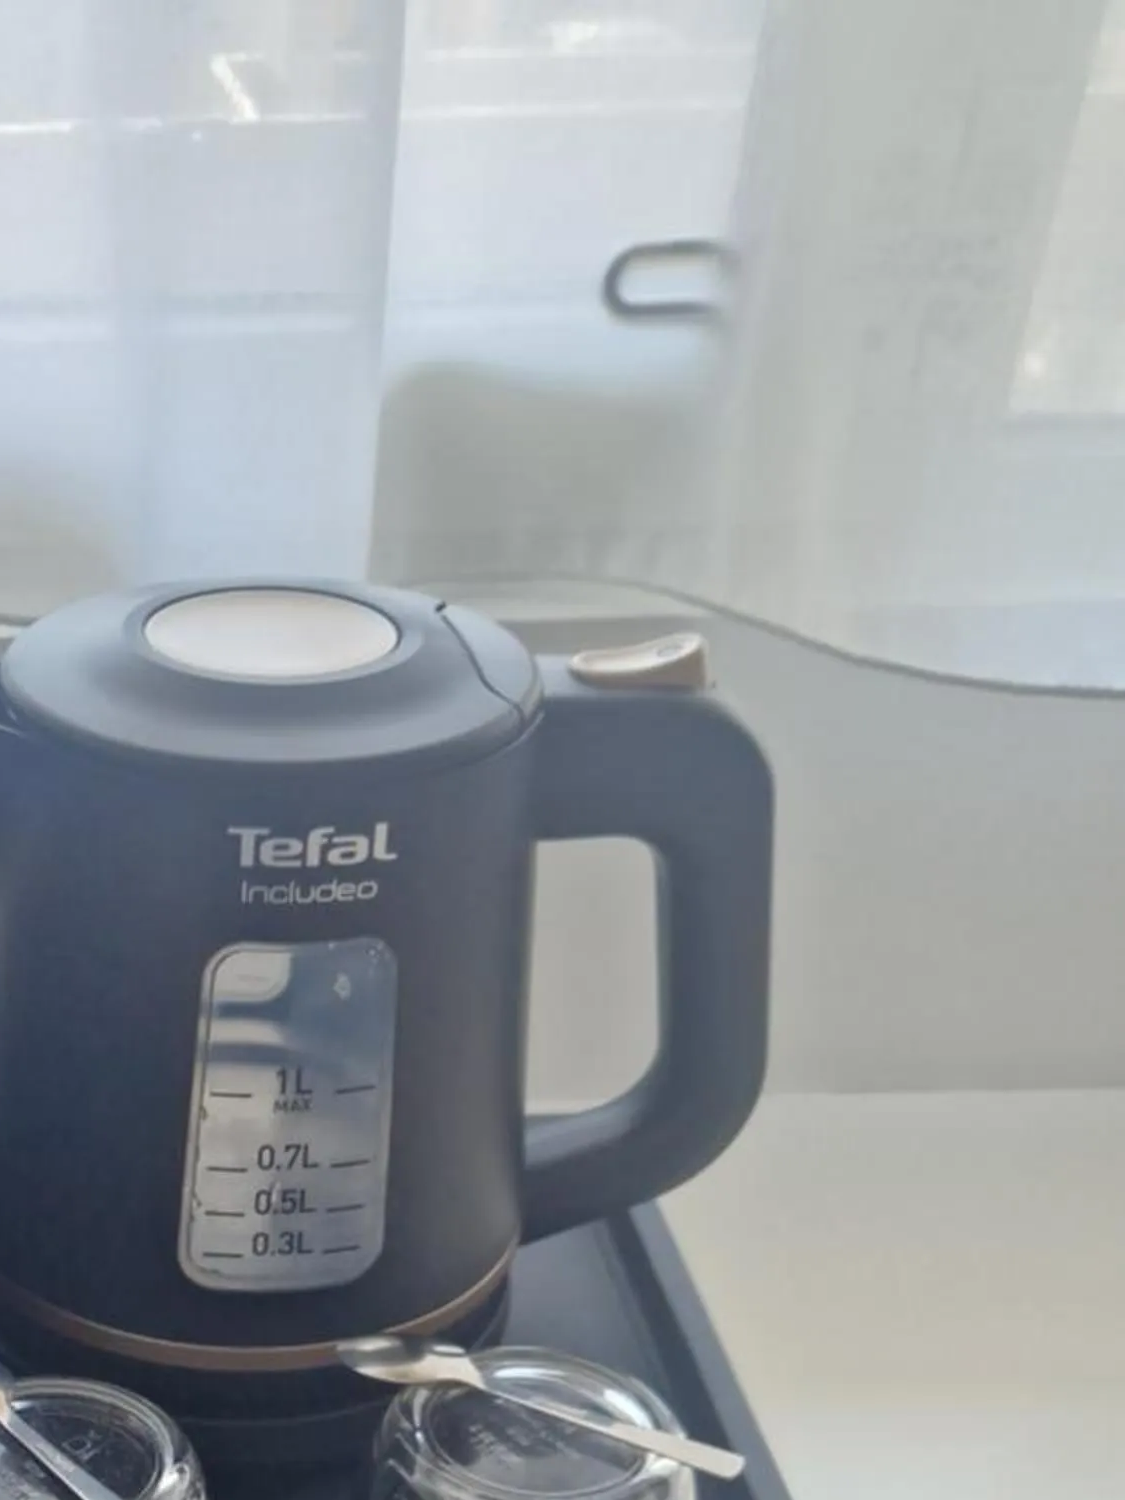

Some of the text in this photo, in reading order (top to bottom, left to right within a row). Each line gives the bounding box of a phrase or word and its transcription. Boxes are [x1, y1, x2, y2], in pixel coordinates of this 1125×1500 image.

[227, 821, 398, 867] Tefal
[241, 879, 379, 904] Includeo
[257, 1143, 320, 1171] 0.7L
[254, 1189, 317, 1216] 0.5L
[251, 1230, 315, 1257] 0.3L
